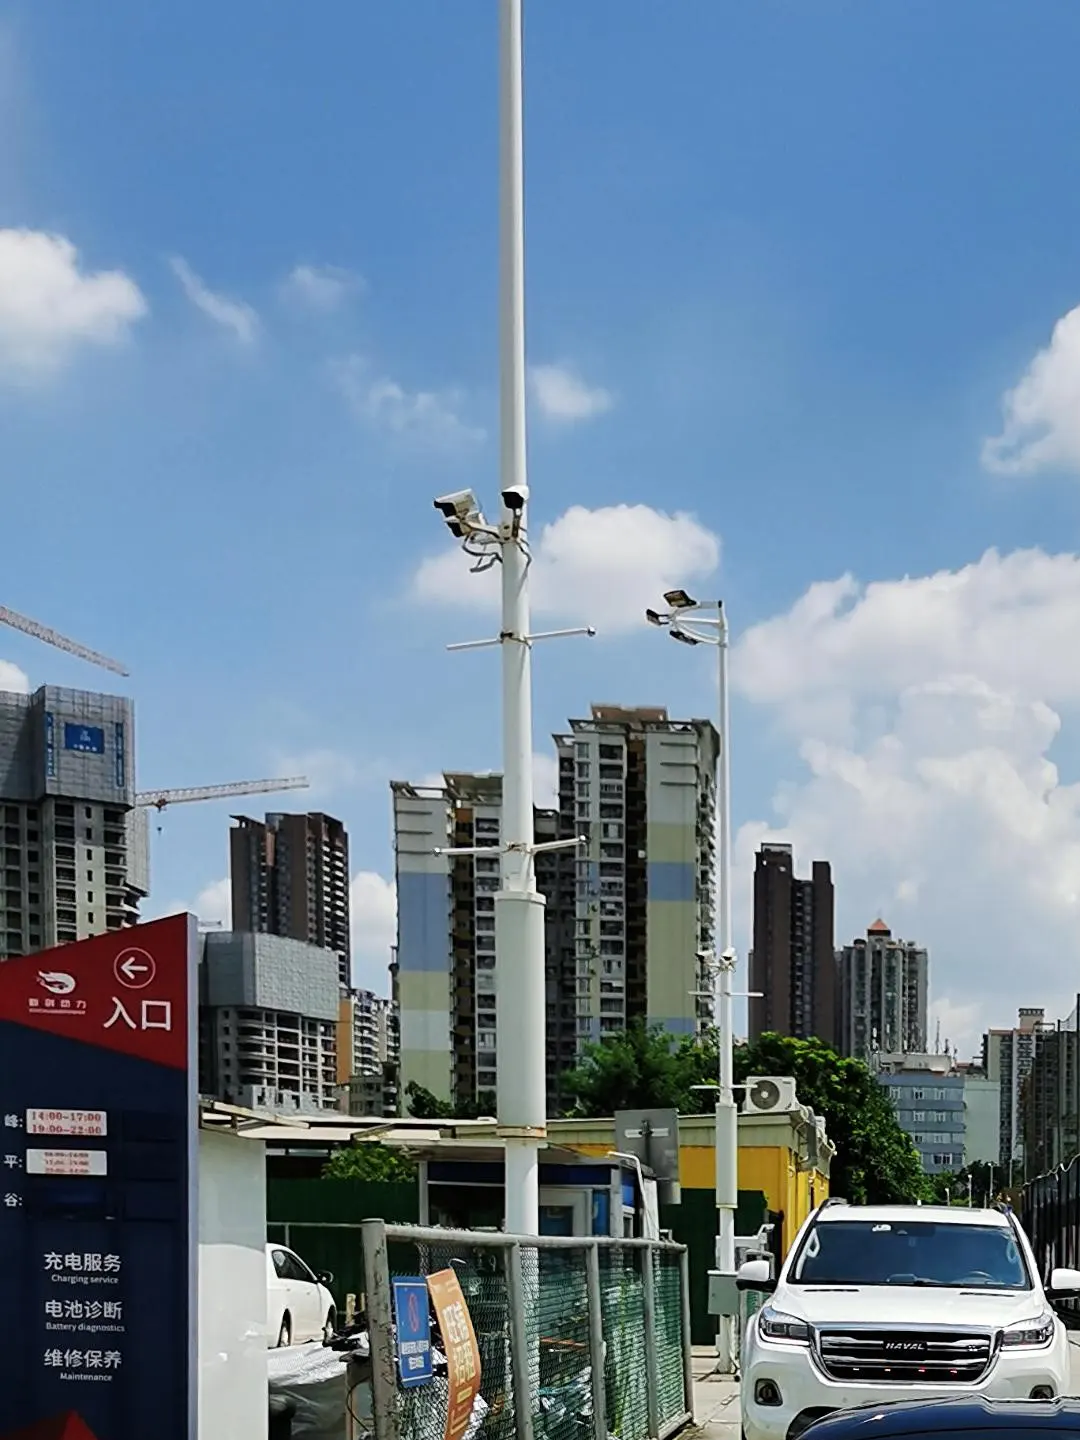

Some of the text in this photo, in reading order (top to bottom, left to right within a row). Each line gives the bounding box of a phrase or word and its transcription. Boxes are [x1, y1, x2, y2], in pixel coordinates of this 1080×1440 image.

[103, 996, 171, 1031] 入口
[44, 1252, 121, 1272] 充电服务
[51, 1274, 119, 1284] Charging service
[45, 1300, 122, 1319] 电池诊断
[46, 1322, 126, 1332] Battery diagnostics
[885, 1342, 925, 1350] HAVAL
[44, 1348, 122, 1368] 维修保养
[60, 1373, 112, 1381] Maintenance
